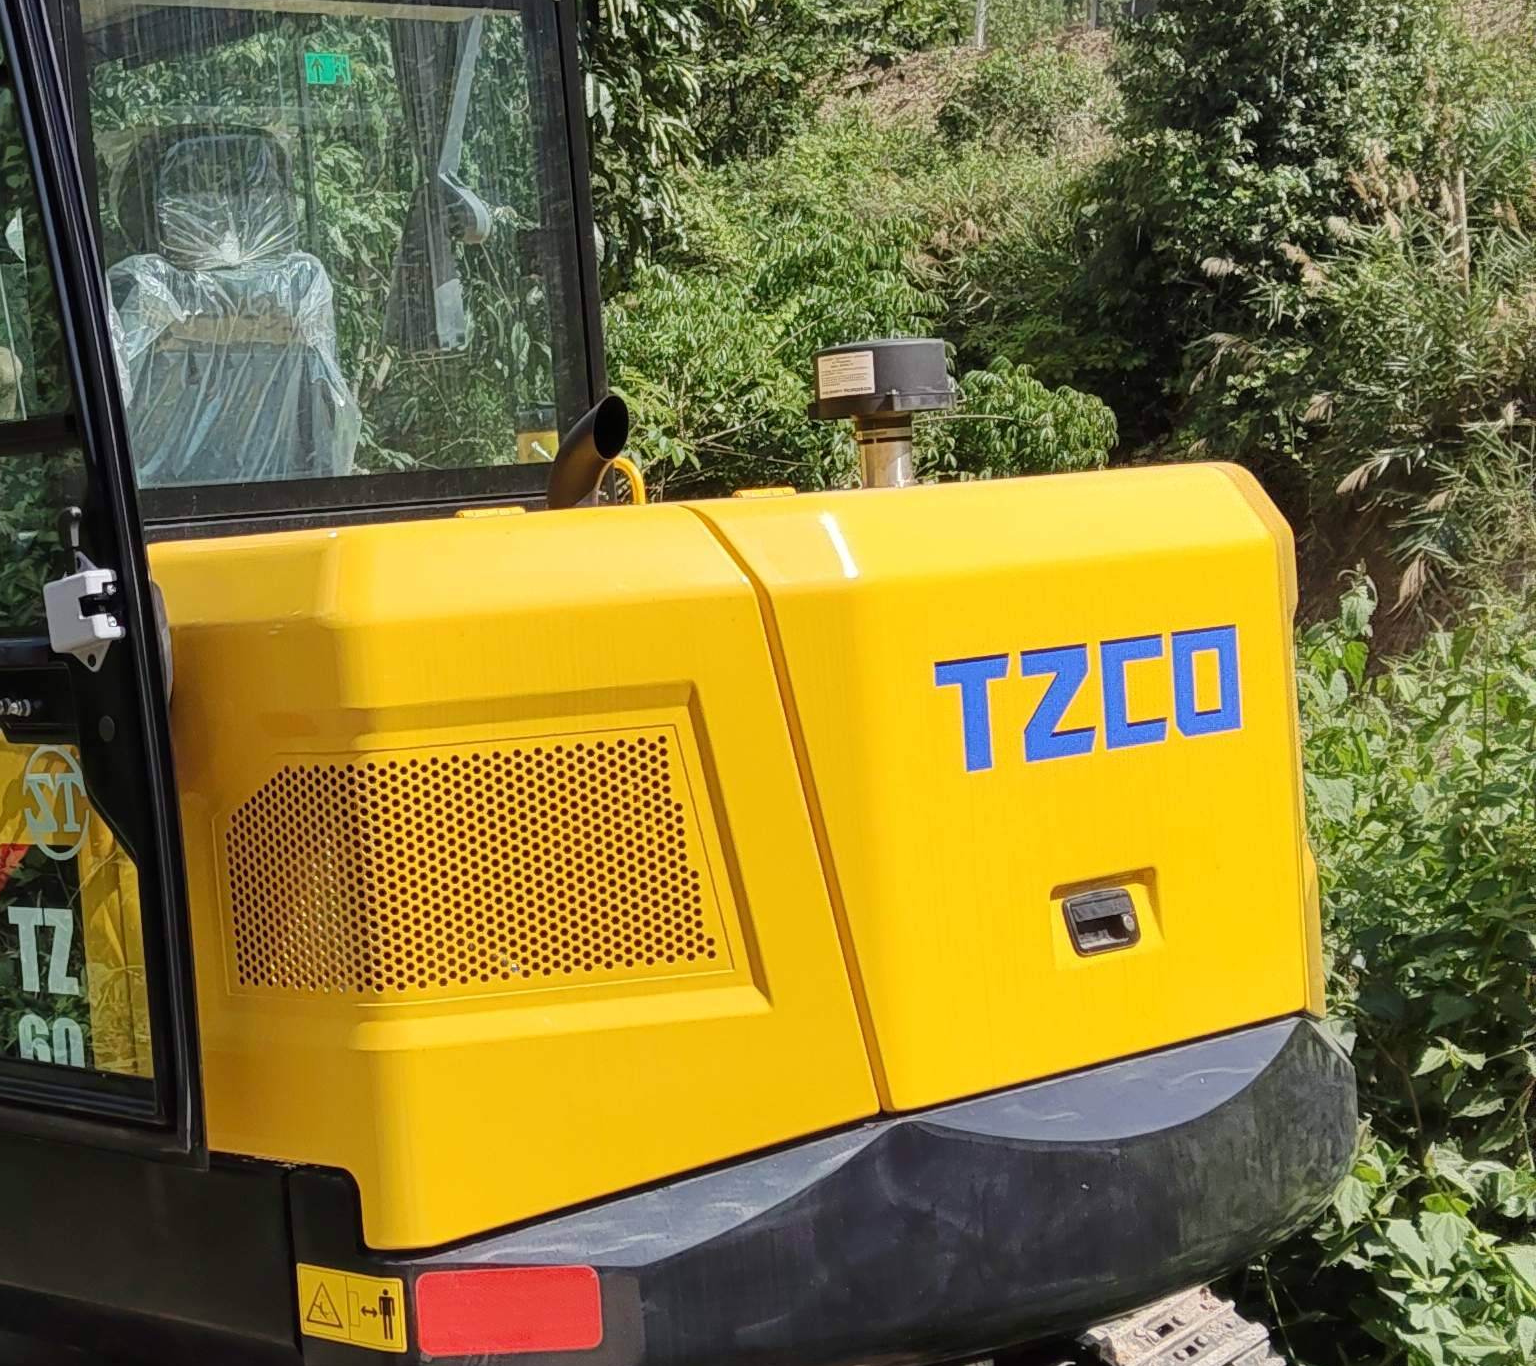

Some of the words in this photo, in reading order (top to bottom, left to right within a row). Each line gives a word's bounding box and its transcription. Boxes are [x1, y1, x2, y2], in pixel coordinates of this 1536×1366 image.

[934, 624, 1242, 773] TZCO
[8, 906, 80, 996] TZ
[18, 1013, 86, 1068] 60
